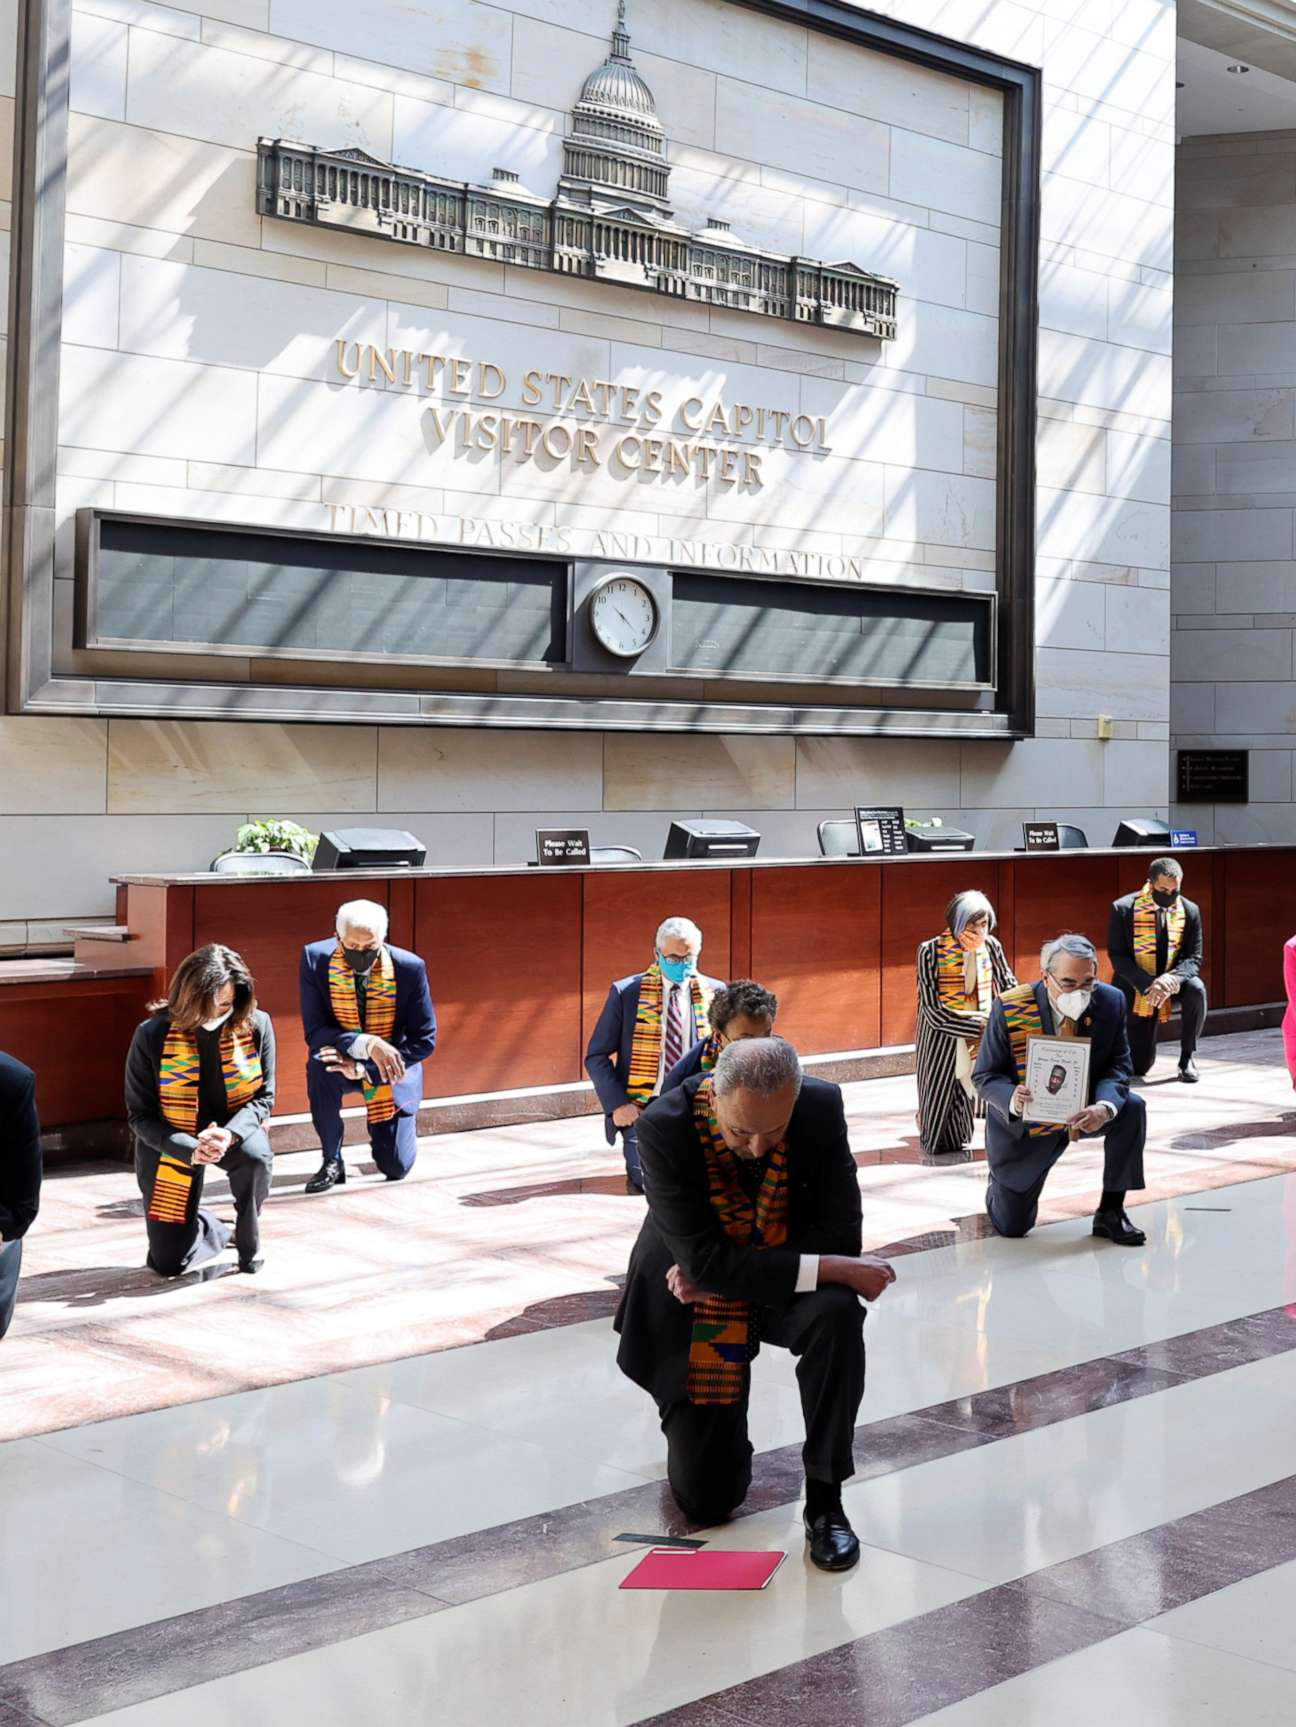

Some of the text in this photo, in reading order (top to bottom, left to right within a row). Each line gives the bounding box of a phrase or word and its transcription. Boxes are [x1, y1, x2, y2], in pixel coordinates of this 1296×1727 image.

[335, 339, 832, 449] UNITED STATES CAPITOL
[428, 407, 764, 486] VISITOR CENTER
[324, 503, 863, 579] TIMED PASSES AND INFORMATION
[543, 847, 586, 856] To Be Called
[544, 839, 583, 847] Please Wait
